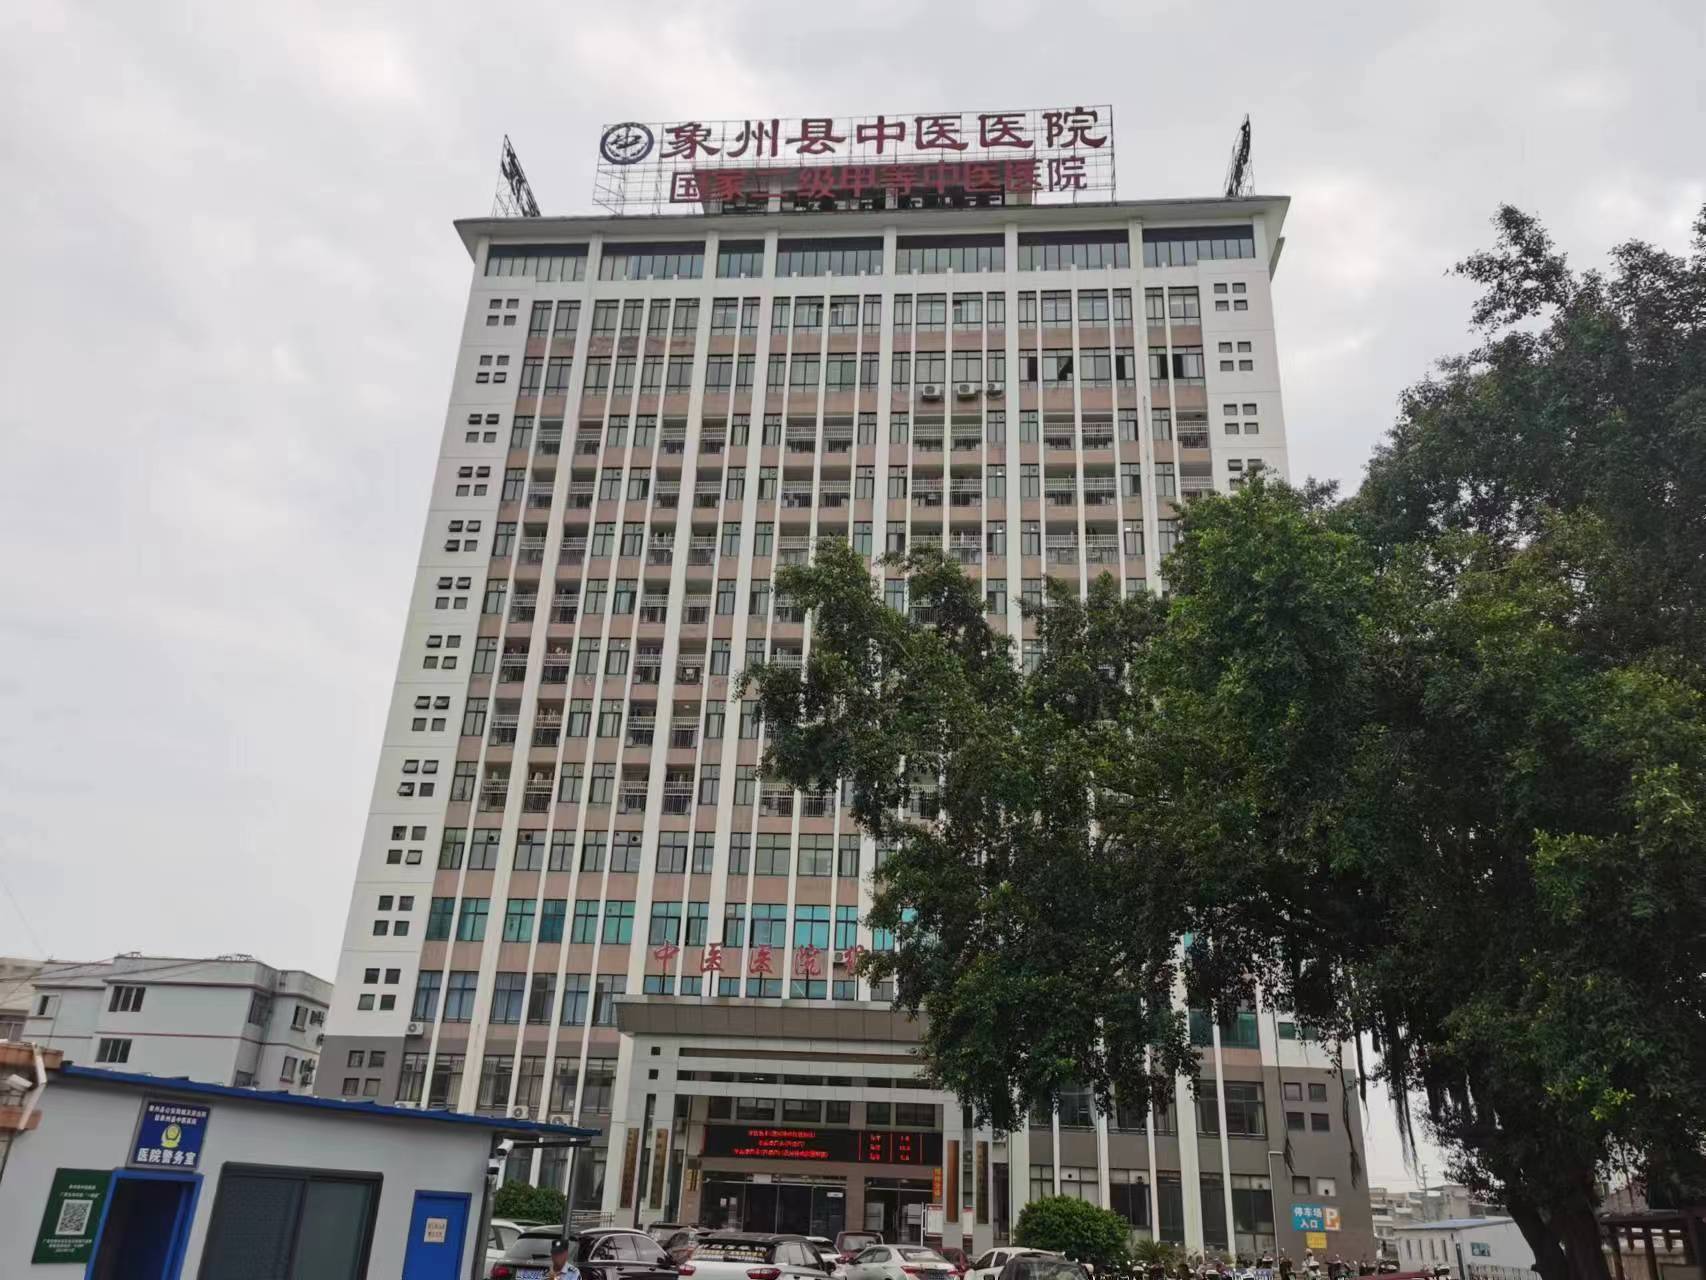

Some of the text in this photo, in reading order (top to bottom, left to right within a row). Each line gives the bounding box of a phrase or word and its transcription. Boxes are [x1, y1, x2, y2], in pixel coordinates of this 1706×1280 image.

[660, 107, 1107, 160] 象州县中医医院
[669, 156, 1087, 203] 国家二级甲等中医医院
[136, 1147, 197, 1165] 医院警务室
[1294, 1207, 1323, 1218] 停车场
[1300, 1219, 1318, 1229] 入口
